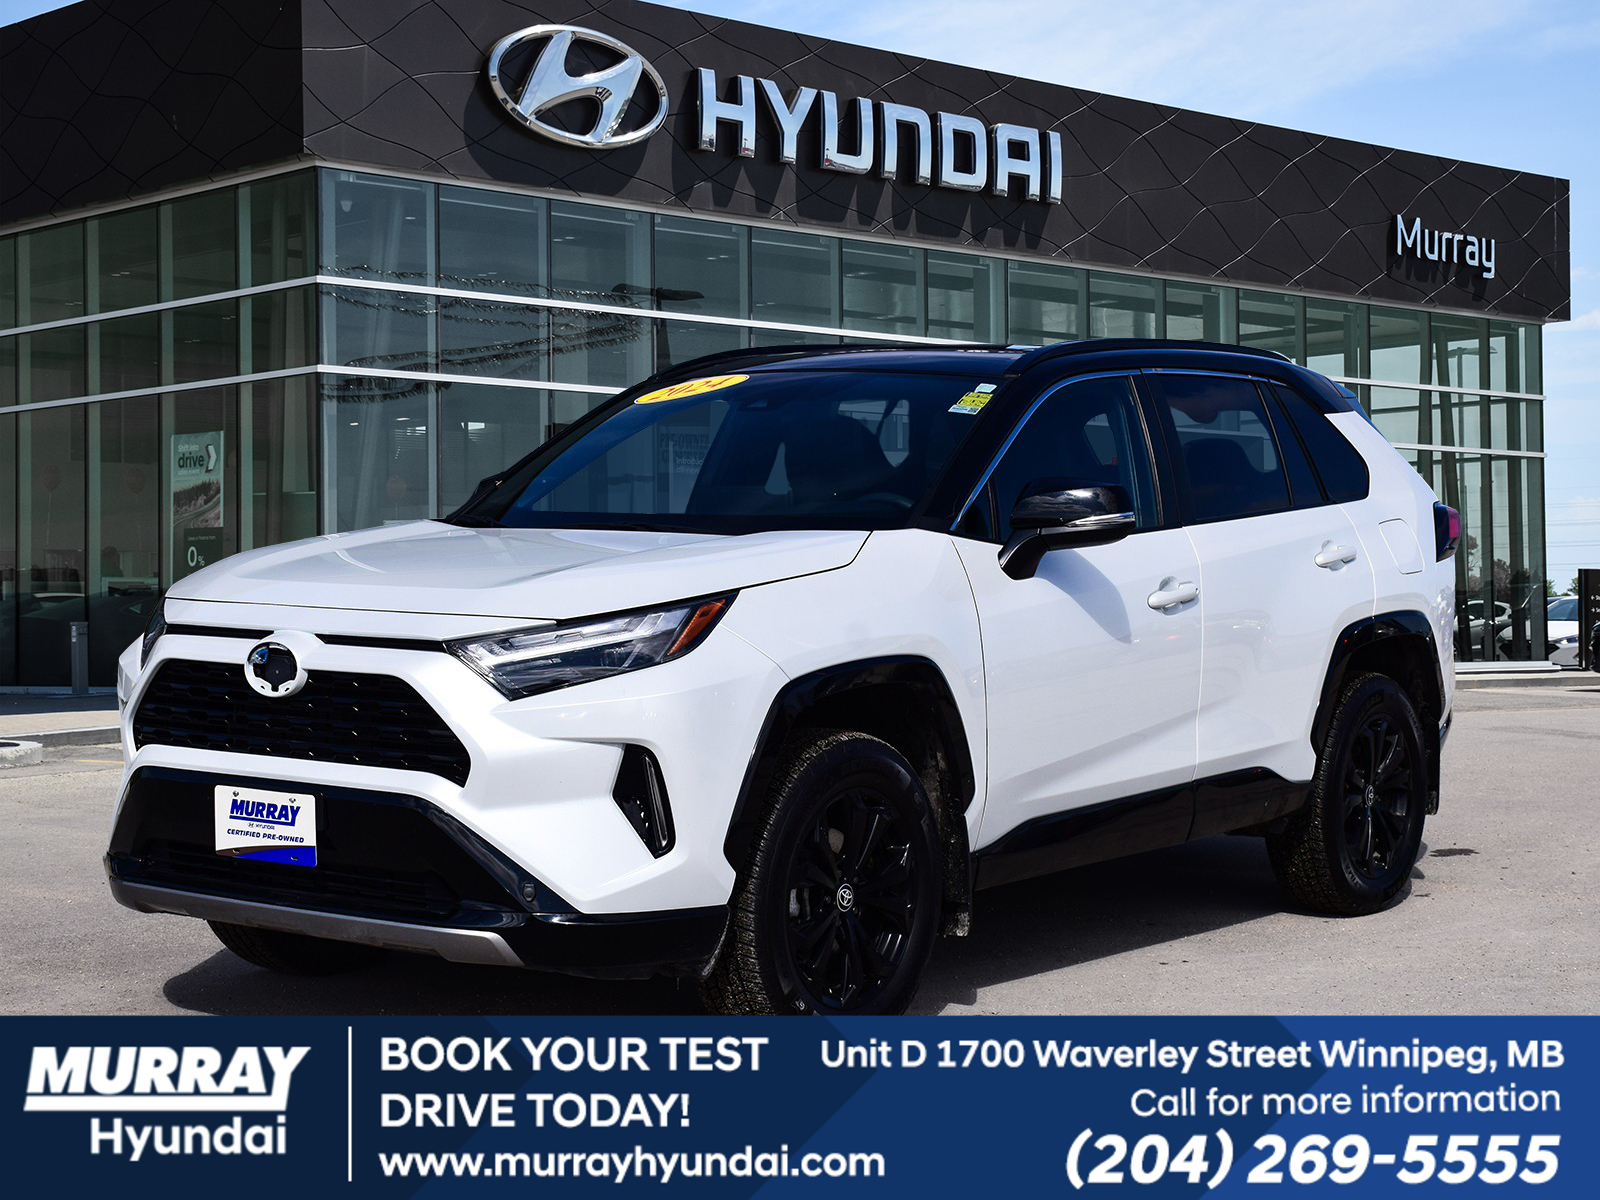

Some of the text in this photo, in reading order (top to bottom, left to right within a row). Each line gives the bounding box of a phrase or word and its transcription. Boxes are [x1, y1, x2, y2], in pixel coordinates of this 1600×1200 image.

[696, 67, 1063, 205] HYUNDAI
[1396, 213, 1496, 279] Murray
[178, 451, 205, 469] drive
[229, 798, 301, 824] MURRAY
[227, 828, 305, 844] CERTIFIED PRE-OWNED
